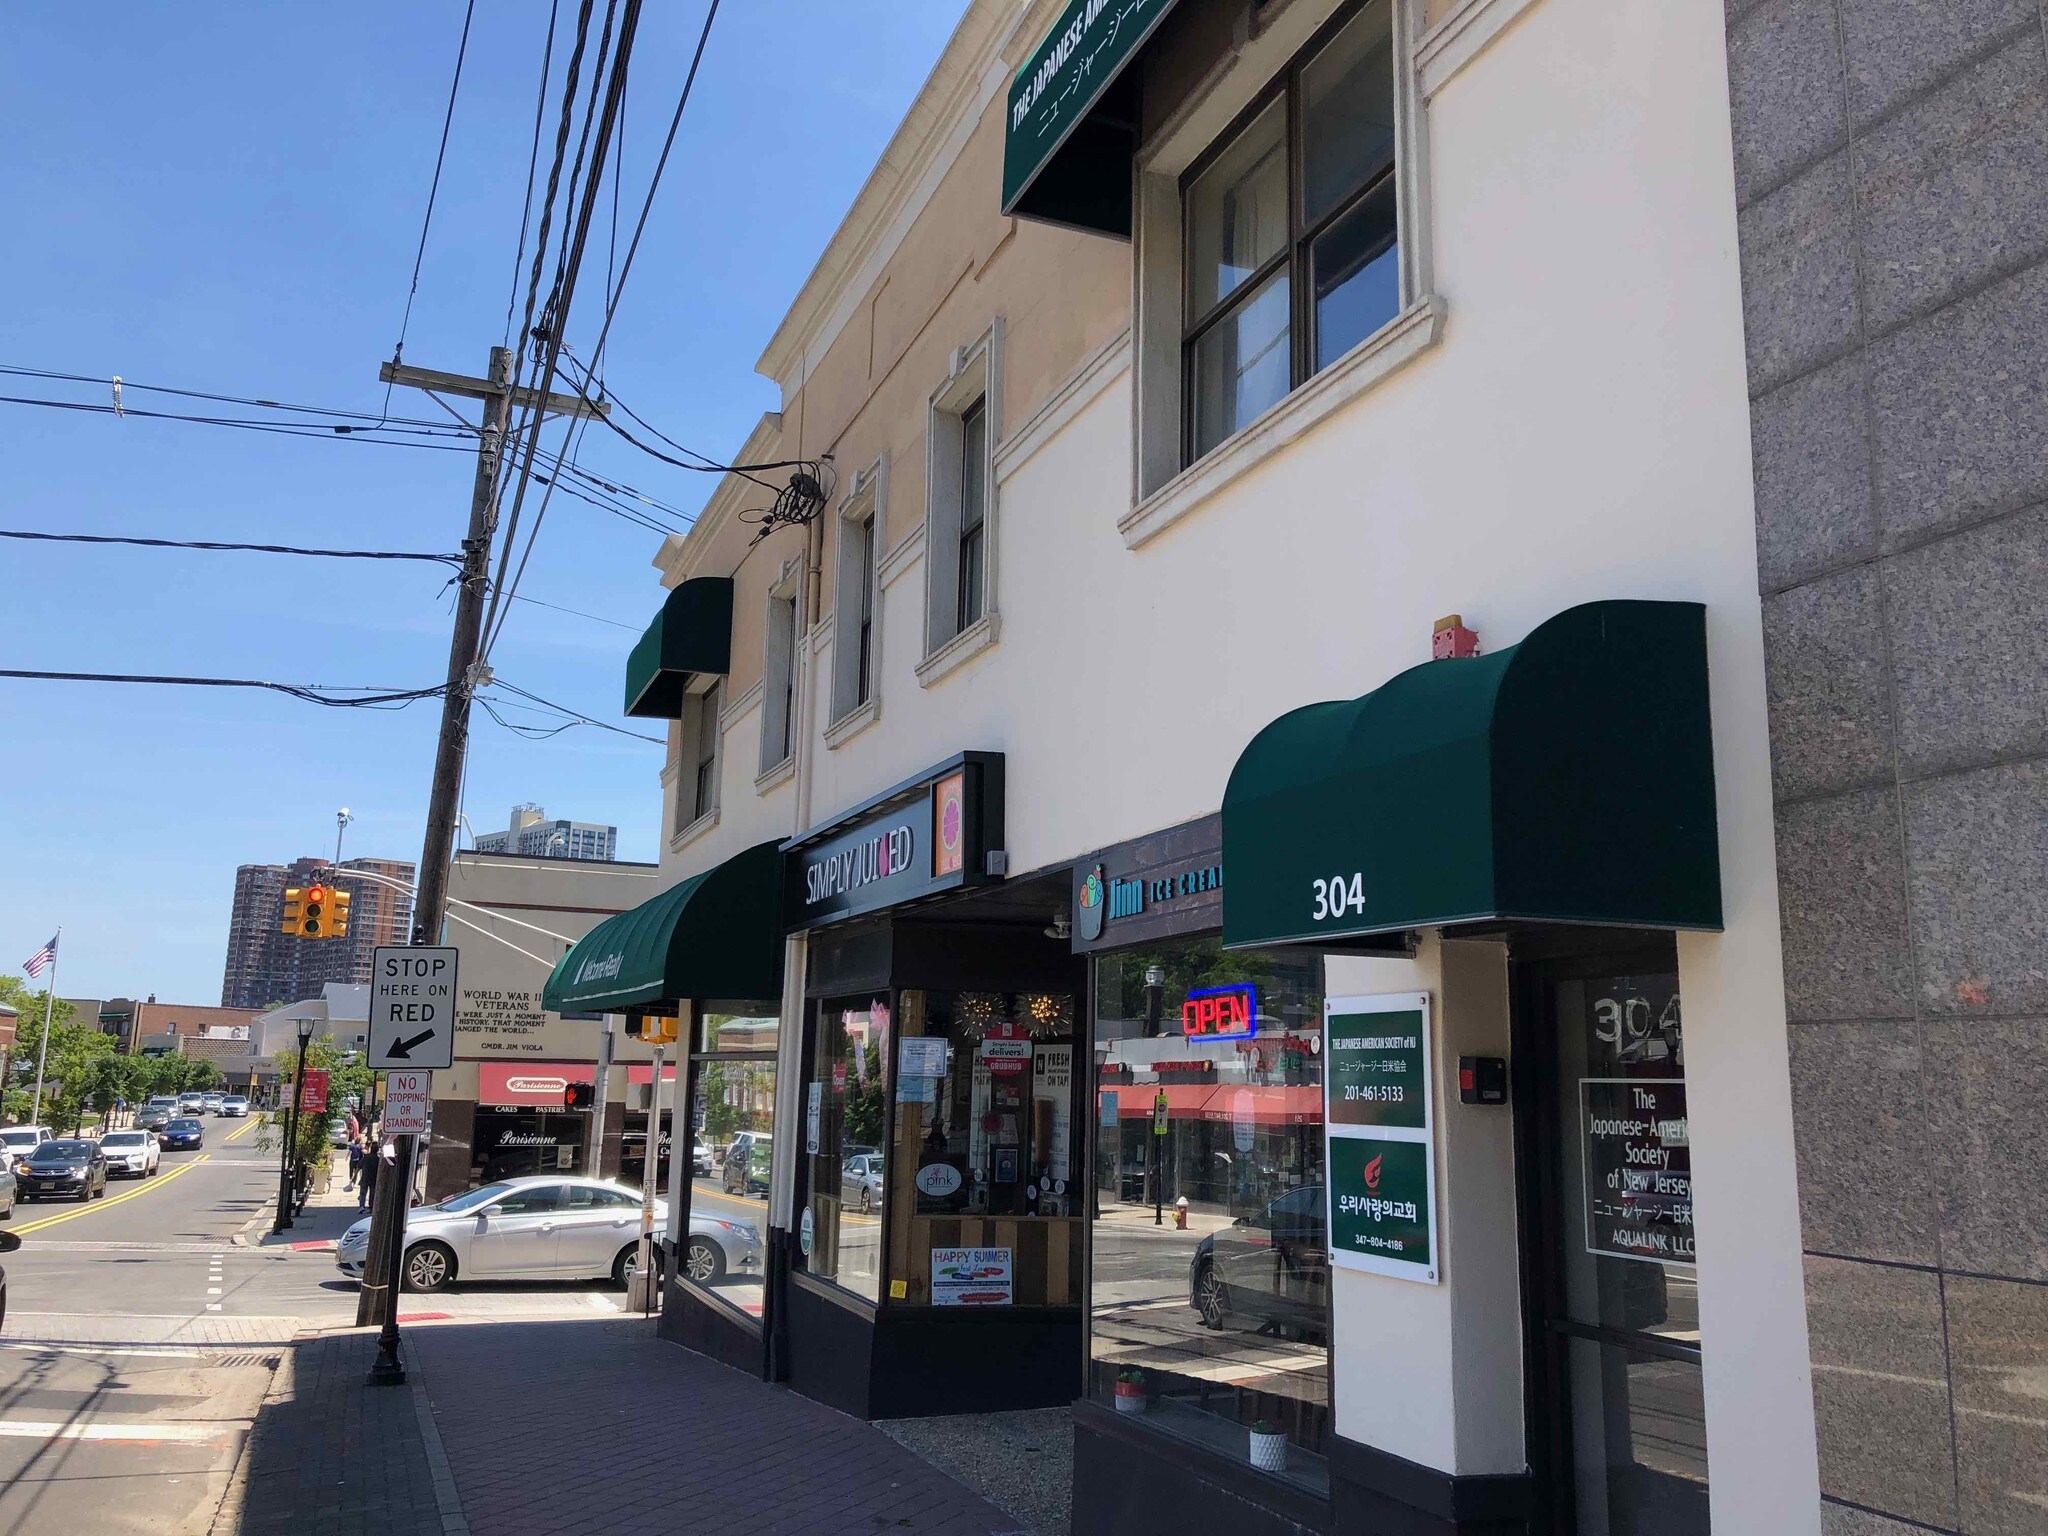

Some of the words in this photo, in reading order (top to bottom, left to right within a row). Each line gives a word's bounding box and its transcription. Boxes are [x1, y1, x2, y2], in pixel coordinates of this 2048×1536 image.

[1013, 85, 1031, 132] THE
[1031, 11, 1083, 107] JAPANESE
[806, 848, 857, 905] SIMPLY
[1109, 878, 1143, 919] Jinn
[1150, 878, 1173, 903] ICE
[1313, 872, 1366, 921] 304
[385, 958, 446, 977] STOP
[380, 984, 420, 996] HERE
[428, 984, 448, 997] ON
[463, 990, 502, 1000] WORLD
[507, 992, 530, 1001] WAR
[389, 1003, 435, 1022] RED
[475, 1000, 530, 1011] VETERANS
[1183, 995, 1249, 1035] OPEN
[1594, 994, 1682, 1041] 304
[1332, 1039, 1341, 1050] THE
[1341, 1038, 1361, 1050] JAPANESE
[1362, 1037, 1385, 1049] AMERICAN
[1385, 1037, 1404, 1049] SOCIETY
[1404, 1036, 1410, 1048] of
[1410, 1036, 1416, 1048] NJ
[989, 1048, 1024, 1056] delivers!
[1048, 1053, 1070, 1067] FRESH
[990, 1062, 1022, 1070] GRUBHUB
[1339, 1059, 1407, 1073] ニュージャージー日米協会
[398, 1077, 417, 1090] NO
[513, 1081, 561, 1089] Parisienne
[1047, 1075, 1056, 1086] ON
[388, 1092, 425, 1103] STOPPING
[1344, 1085, 1404, 1101] 201-461-5133
[1633, 1087, 1656, 1109] The
[400, 1105, 411, 1115] OR
[386, 1117, 424, 1128] STANDING
[500, 1130, 557, 1145] Parisienne
[1625, 1141, 1670, 1170] Society
[926, 1168, 953, 1192] pink
[1607, 1168, 1619, 1188] of
[1622, 1168, 1649, 1191] New
[1654, 1170, 1692, 1200] Jersey
[1339, 1194, 1416, 1223] 우리사랑의교회
[1594, 1199, 1692, 1225] ニュージャージー日米
[1355, 1234, 1403, 1251] 347-804-4186
[1612, 1228, 1668, 1250] AQUALINK
[1672, 1236, 1693, 1254] LLC
[934, 1251, 971, 1263] HAPPY
[974, 1250, 1009, 1263] SUMMER
